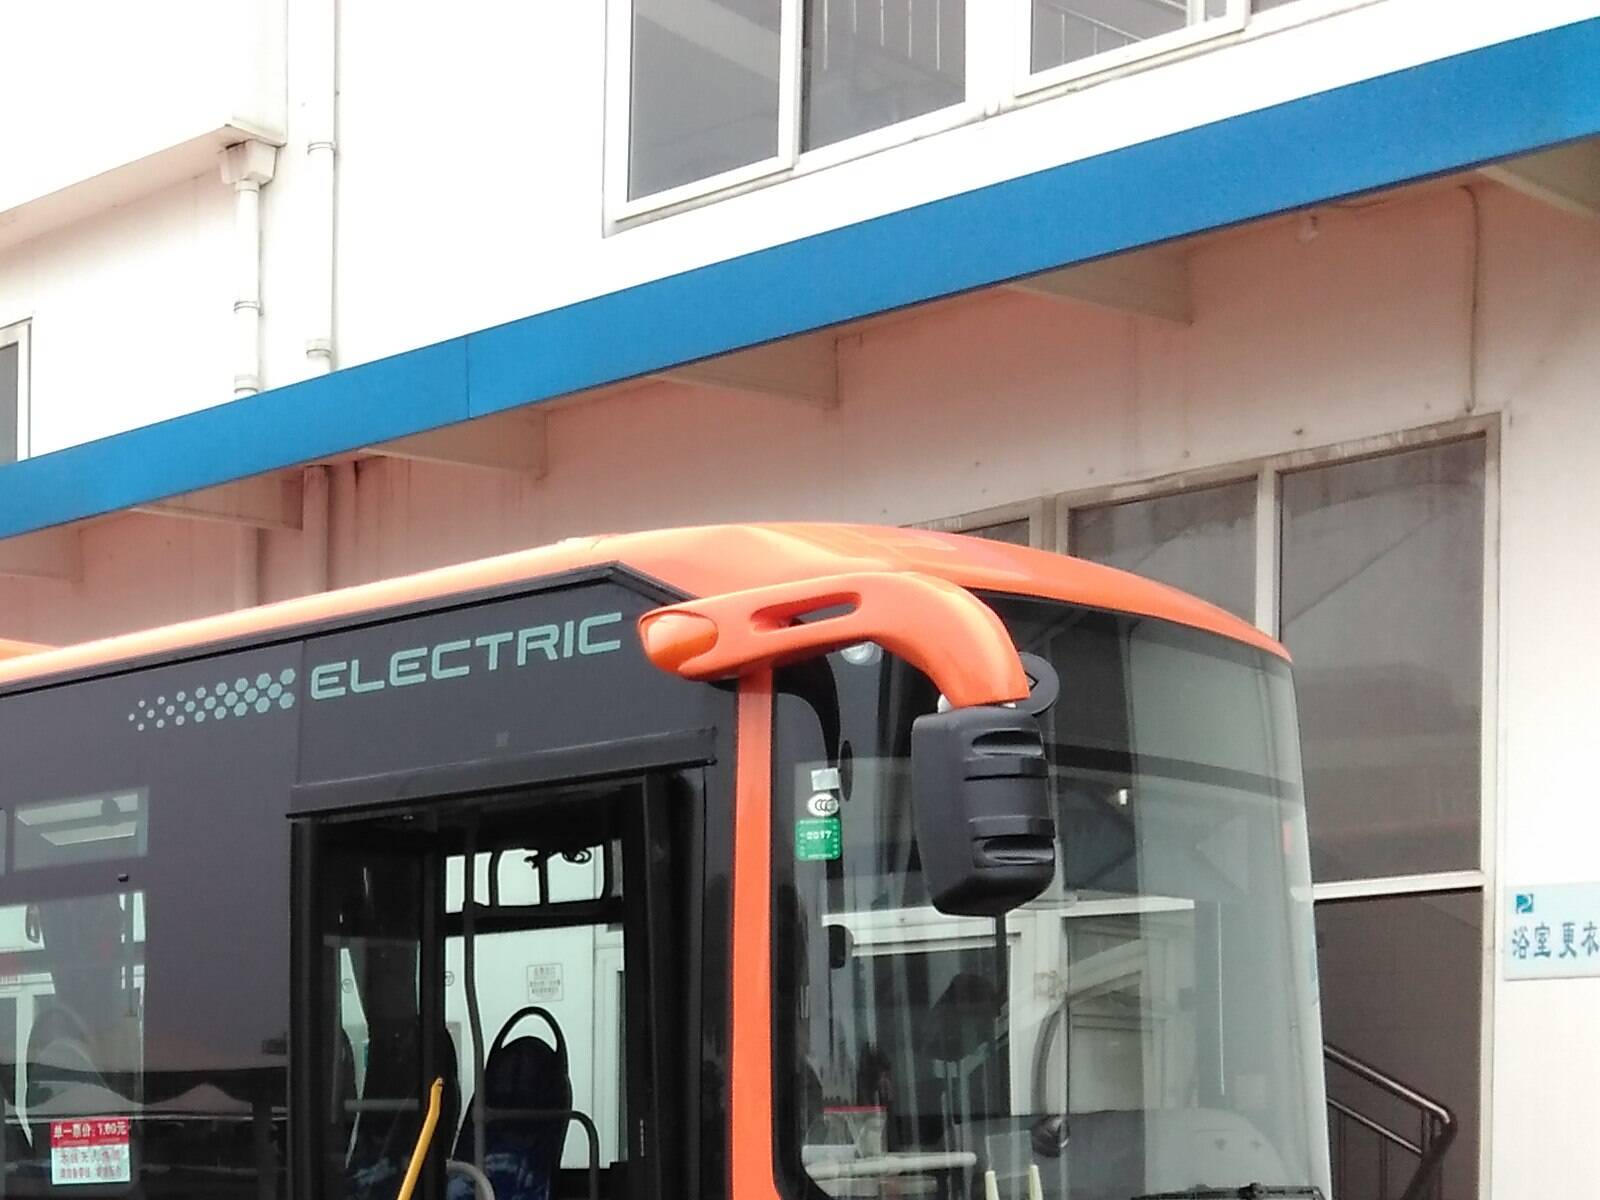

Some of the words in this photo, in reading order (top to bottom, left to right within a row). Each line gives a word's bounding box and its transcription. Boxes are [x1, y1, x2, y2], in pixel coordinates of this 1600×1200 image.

[311, 612, 622, 700] ELECTRIC
[1512, 921, 1599, 959] 浴室更衣
